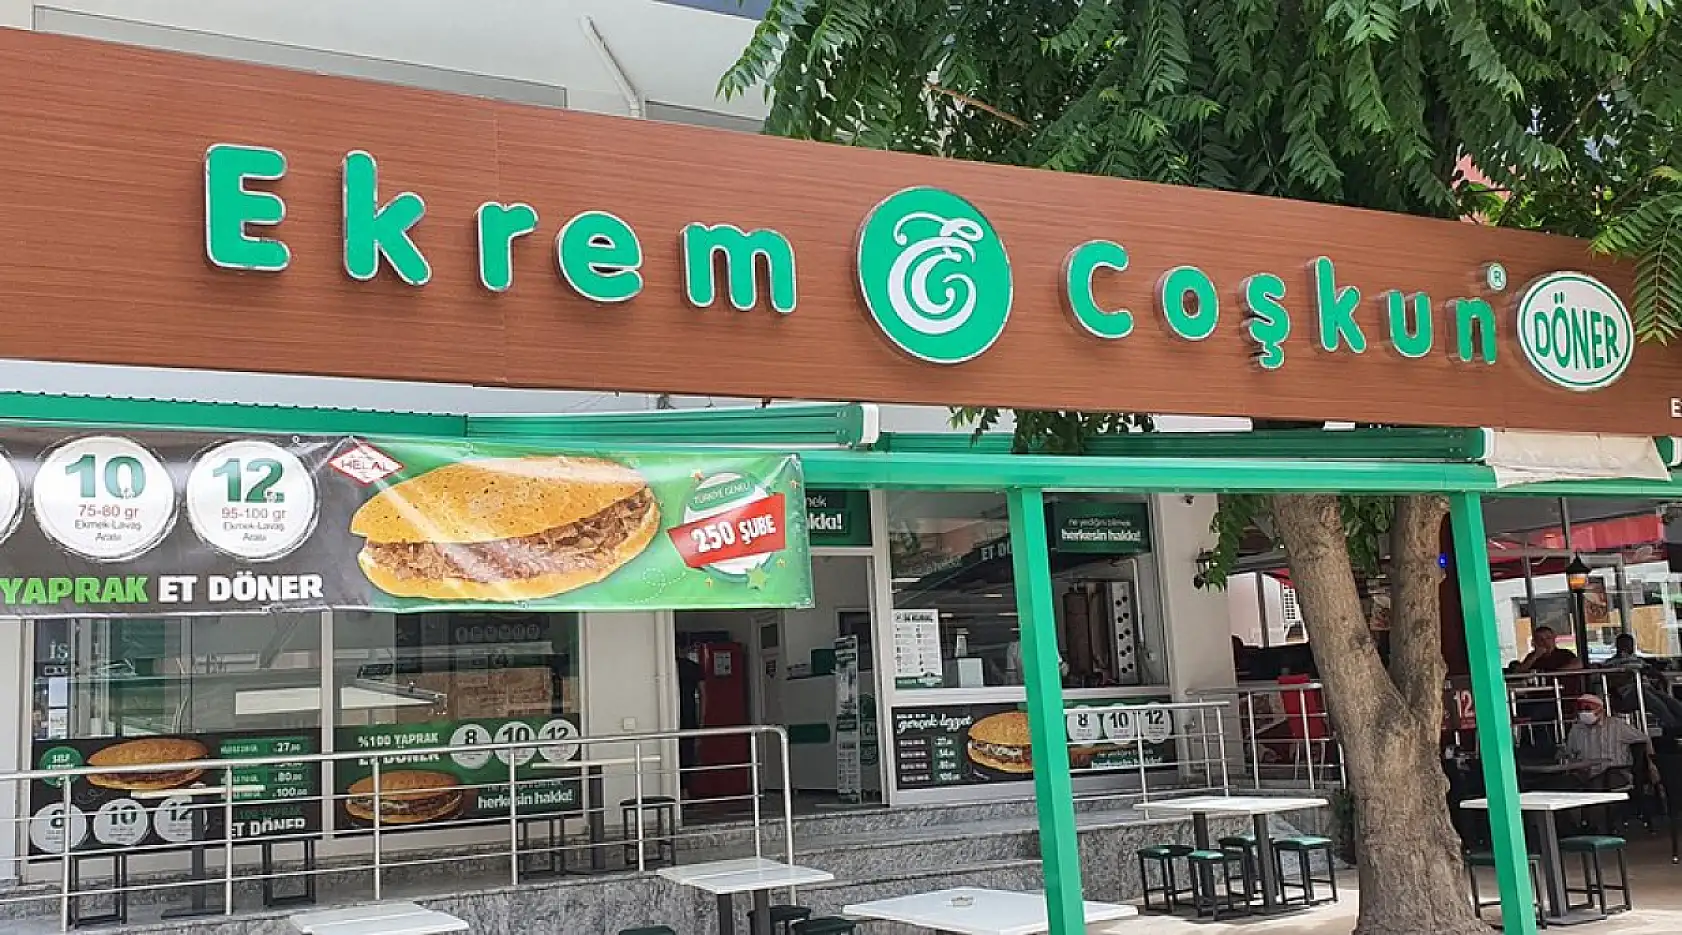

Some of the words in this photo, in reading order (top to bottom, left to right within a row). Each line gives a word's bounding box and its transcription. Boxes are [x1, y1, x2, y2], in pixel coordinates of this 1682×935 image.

[205, 143, 798, 313] Ekrem
[1061, 239, 1497, 368] Coşkun
[1533, 291, 1620, 370] DÖNER
[1671, 397, 1682, 418] E
[65, 453, 147, 499] 10
[210, 457, 284, 504] 12
[341, 458, 391, 473] HELAL
[124, 506, 140, 520] gr
[807, 512, 842, 530] kkı!
[691, 521, 736, 553] 250
[738, 513, 777, 545] ŞUBE
[0, 576, 148, 604] YAPRAK
[158, 574, 198, 603] ET
[208, 570, 324, 602] DÖNER
[1109, 711, 1129, 729] 10
